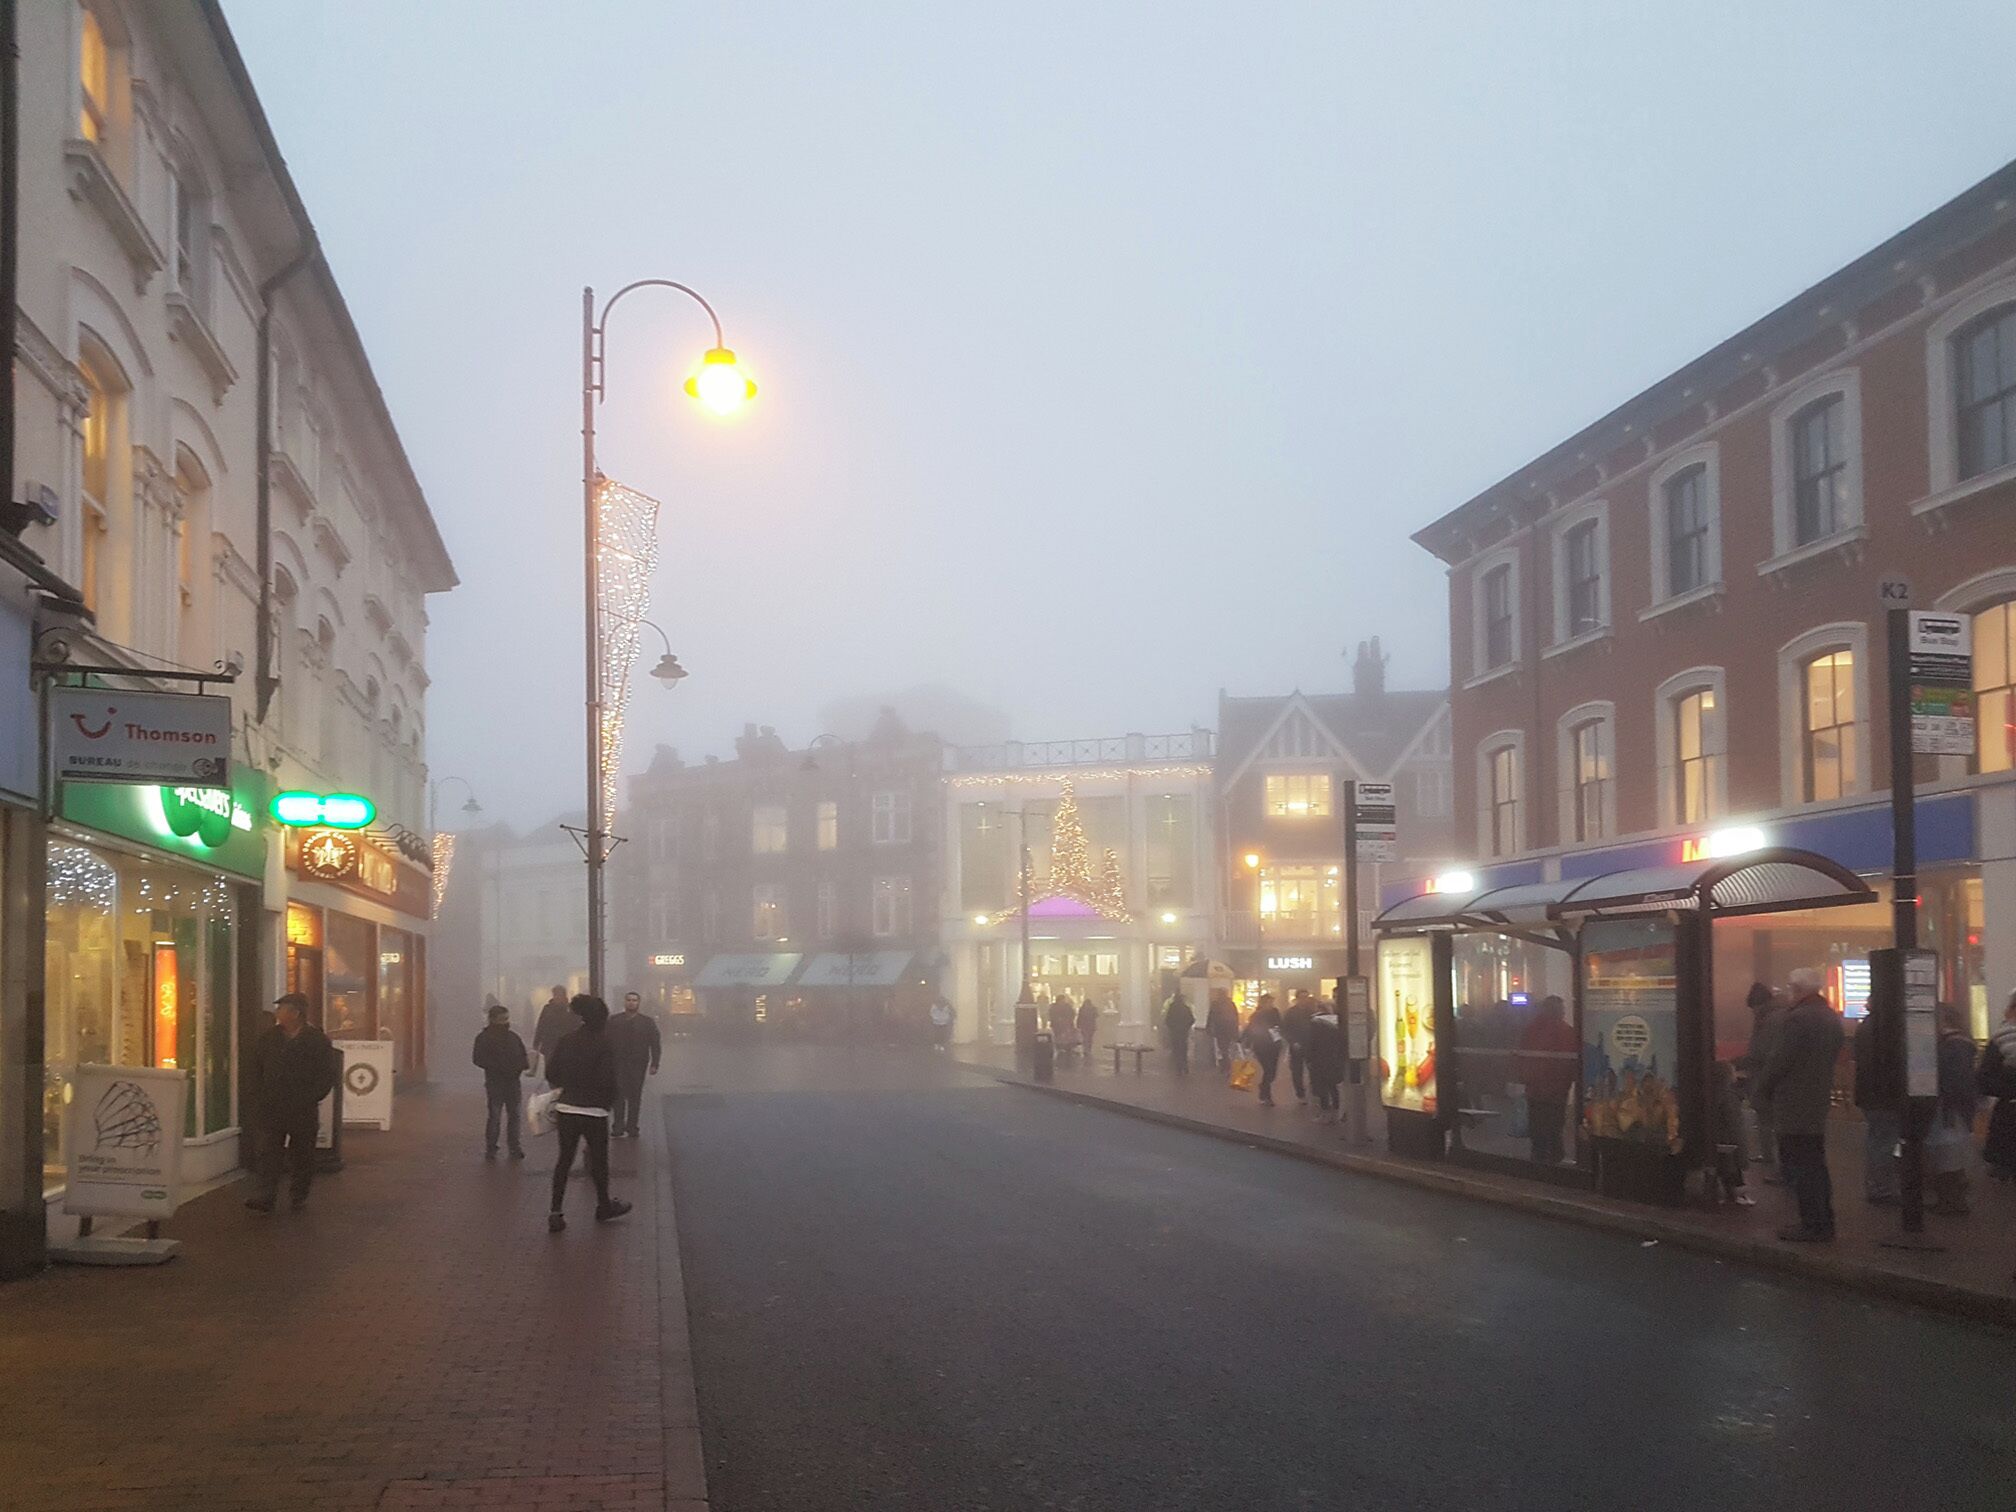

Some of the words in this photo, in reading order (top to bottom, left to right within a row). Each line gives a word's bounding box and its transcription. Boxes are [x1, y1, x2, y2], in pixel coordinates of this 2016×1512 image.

[1881, 582, 1909, 599] K2
[125, 723, 216, 744] Thomson
[69, 755, 122, 767] BUREAU
[655, 955, 685, 965] GREGGS
[1268, 957, 1312, 969] LUSH
